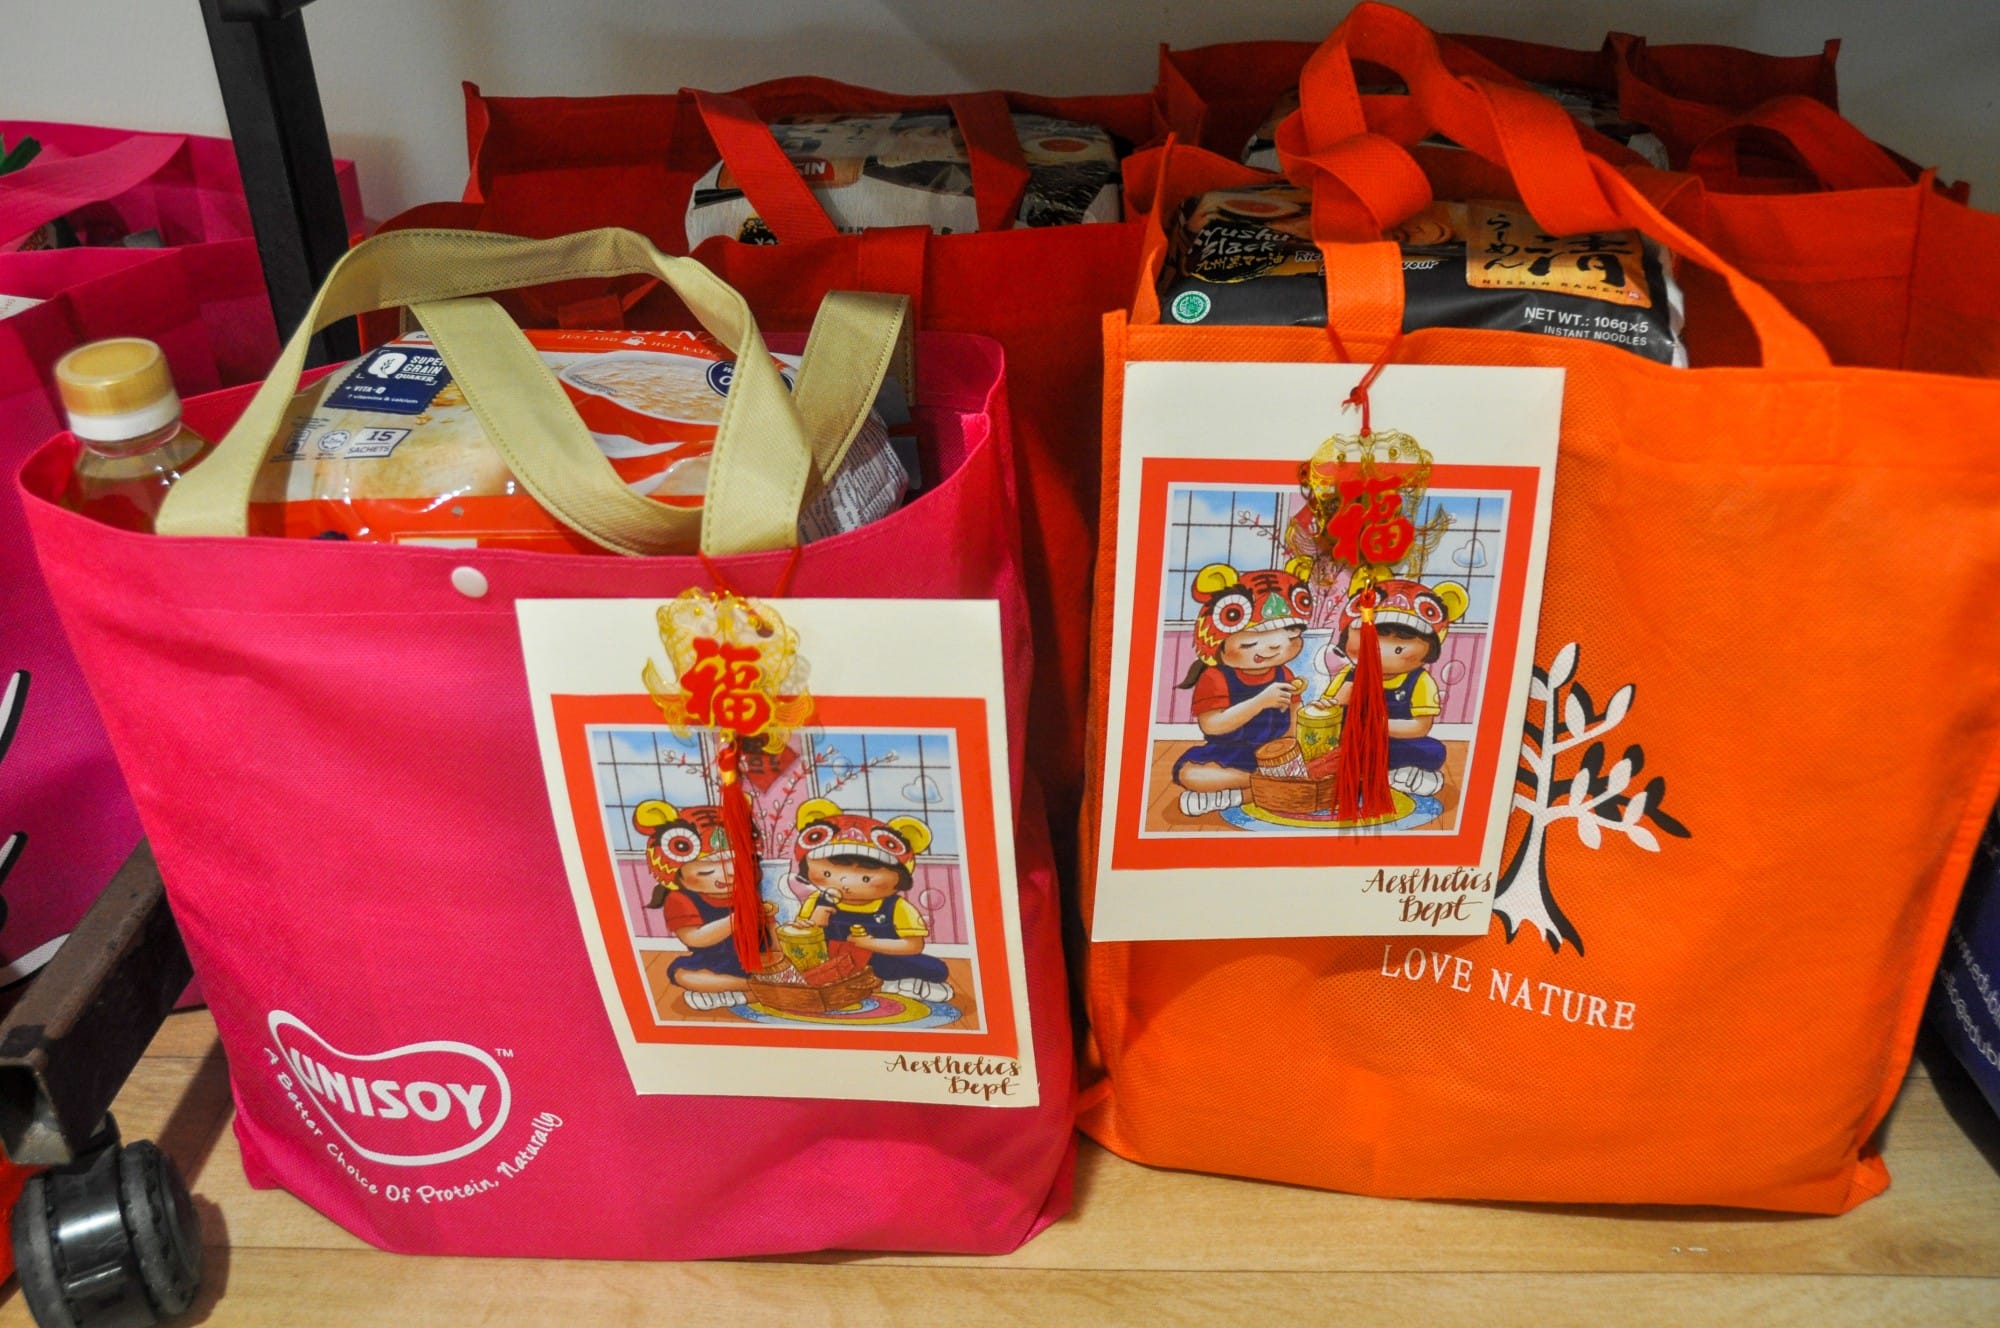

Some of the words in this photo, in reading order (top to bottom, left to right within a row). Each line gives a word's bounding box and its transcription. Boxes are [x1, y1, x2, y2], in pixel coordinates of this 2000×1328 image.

[1524, 306, 1556, 321] NET
[1543, 325, 1590, 339] INSTANT
[1593, 331, 1648, 346] NOODLES
[402, 363, 443, 375] GRAIN
[410, 355, 445, 366] SUPE
[394, 373, 435, 383] QUAKER
[366, 430, 394, 442] 15
[347, 445, 391, 455] SACHETS
[680, 636, 772, 735] 福
[1361, 866, 1493, 894] Aesthetics
[1399, 894, 1483, 928] Dept
[1381, 944, 1473, 993] LOVE
[1488, 967, 1636, 1031] NATURE
[884, 1053, 1022, 1077] Aesthetics
[289, 1047, 487, 1130] UNISOY
[944, 1075, 1020, 1102] Dept
[263, 1046, 279, 1065] A
[277, 1071, 324, 1138] Better
[327, 1143, 379, 1196] Choice
[384, 1184, 411, 1203] Of
[416, 1178, 500, 1205] Protein,
[496, 1110, 564, 1179] Naturally
